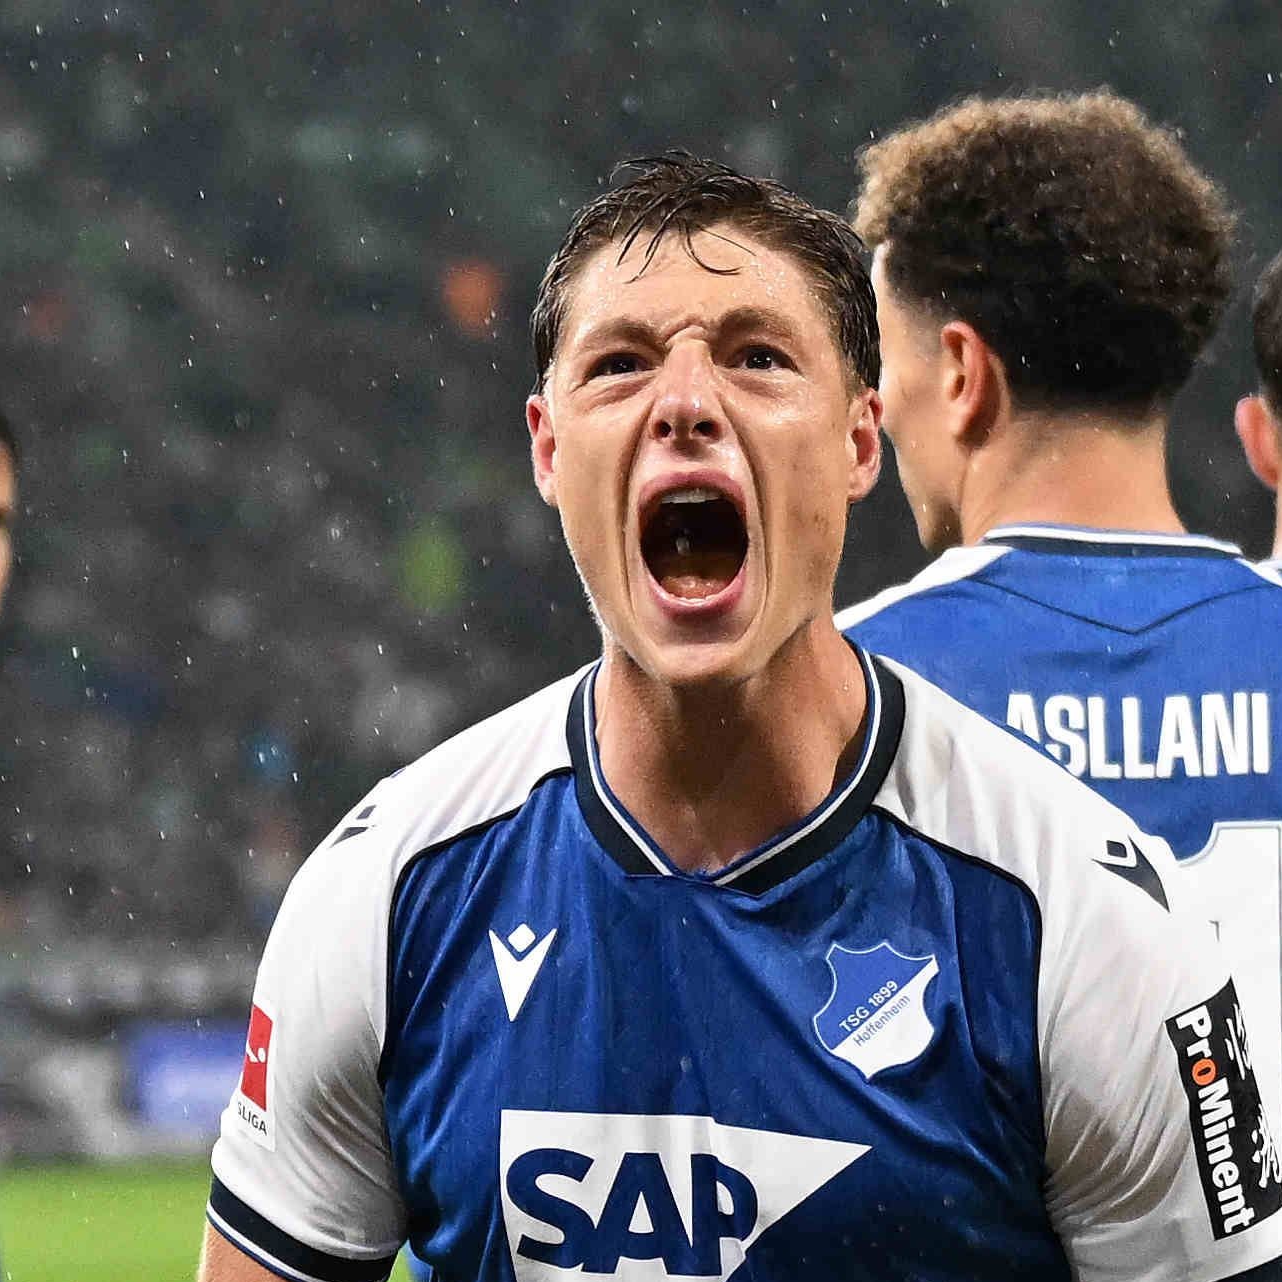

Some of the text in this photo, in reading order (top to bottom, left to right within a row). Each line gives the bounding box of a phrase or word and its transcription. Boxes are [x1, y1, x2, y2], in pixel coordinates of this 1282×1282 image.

[839, 980, 899, 1033] TSG 1899
[1175, 1004, 1255, 1234] ProMinent
[504, 1147, 759, 1277] SAP
